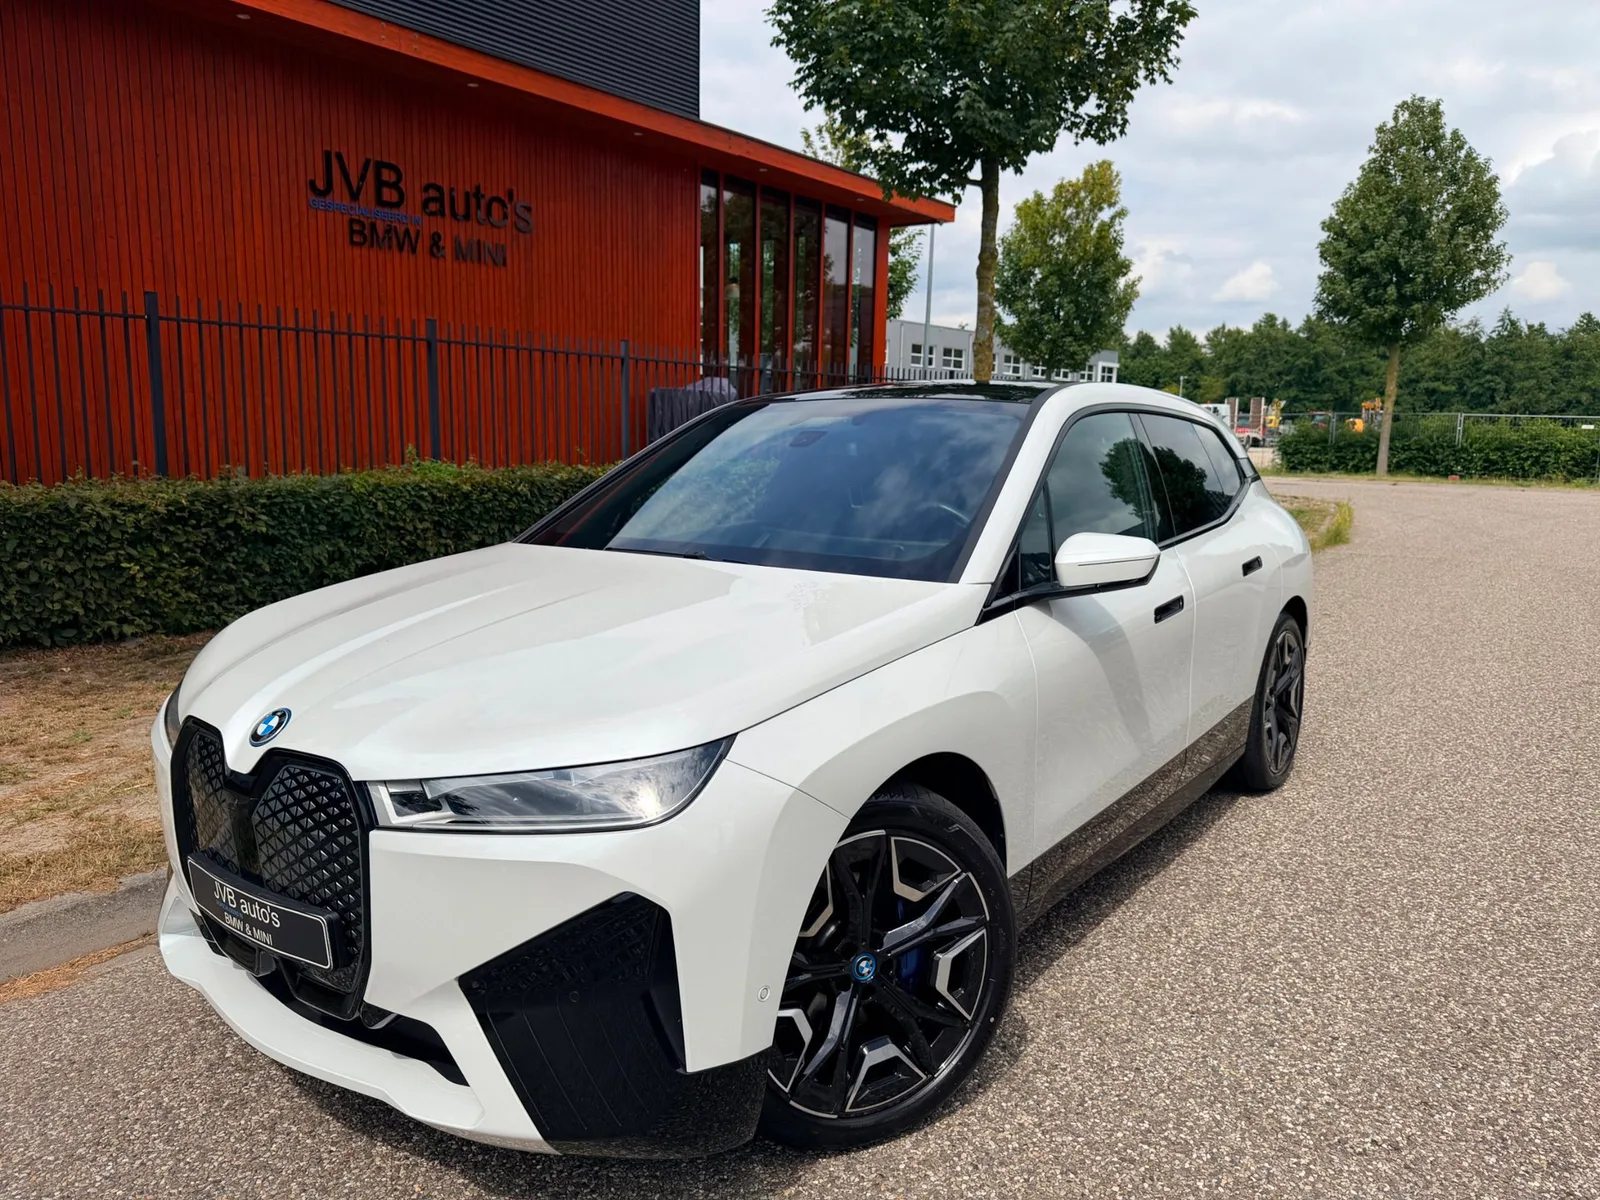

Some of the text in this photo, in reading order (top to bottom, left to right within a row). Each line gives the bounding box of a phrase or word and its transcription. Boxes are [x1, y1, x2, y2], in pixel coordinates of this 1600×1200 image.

[309, 149, 533, 234] JVB auto's
[309, 197, 422, 227] GESPECIALISEERD IN
[348, 218, 507, 267] BMW & MINI
[213, 881, 237, 908] JVB
[239, 899, 281, 928] auto's
[224, 911, 273, 946] BMW & MINI
